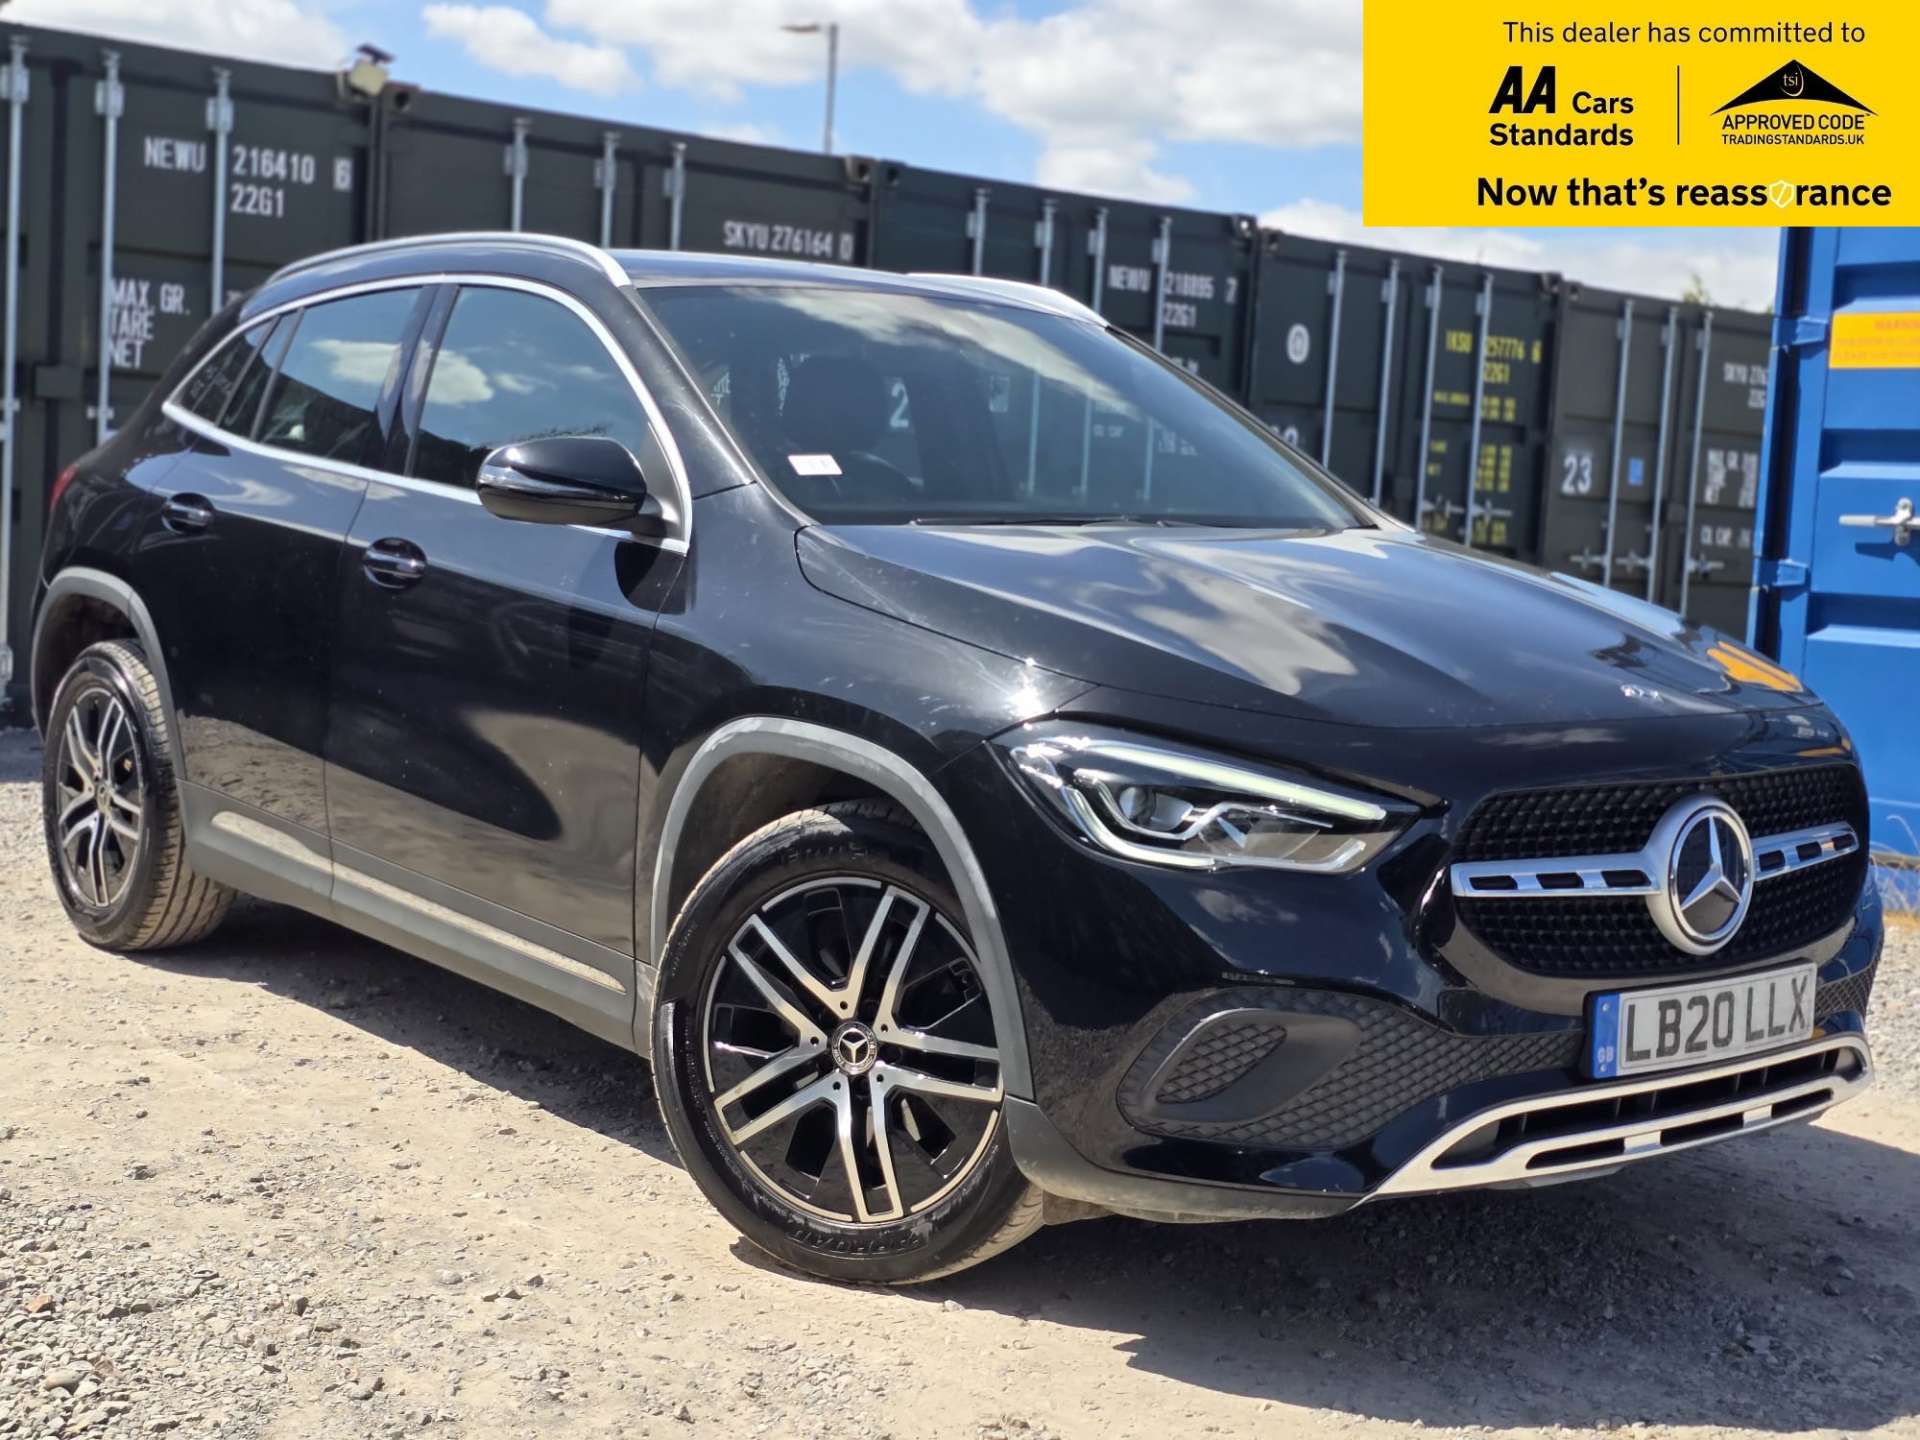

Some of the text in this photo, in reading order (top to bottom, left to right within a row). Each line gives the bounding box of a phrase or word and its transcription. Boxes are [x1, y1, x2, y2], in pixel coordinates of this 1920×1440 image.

[144, 135, 207, 172] NEWU
[232, 145, 315, 184] 216410
[230, 182, 285, 218] 22G1
[723, 220, 769, 250] SKYU
[1561, 454, 1593, 496] 23
[1625, 974, 1808, 1062] LB20 LLX
